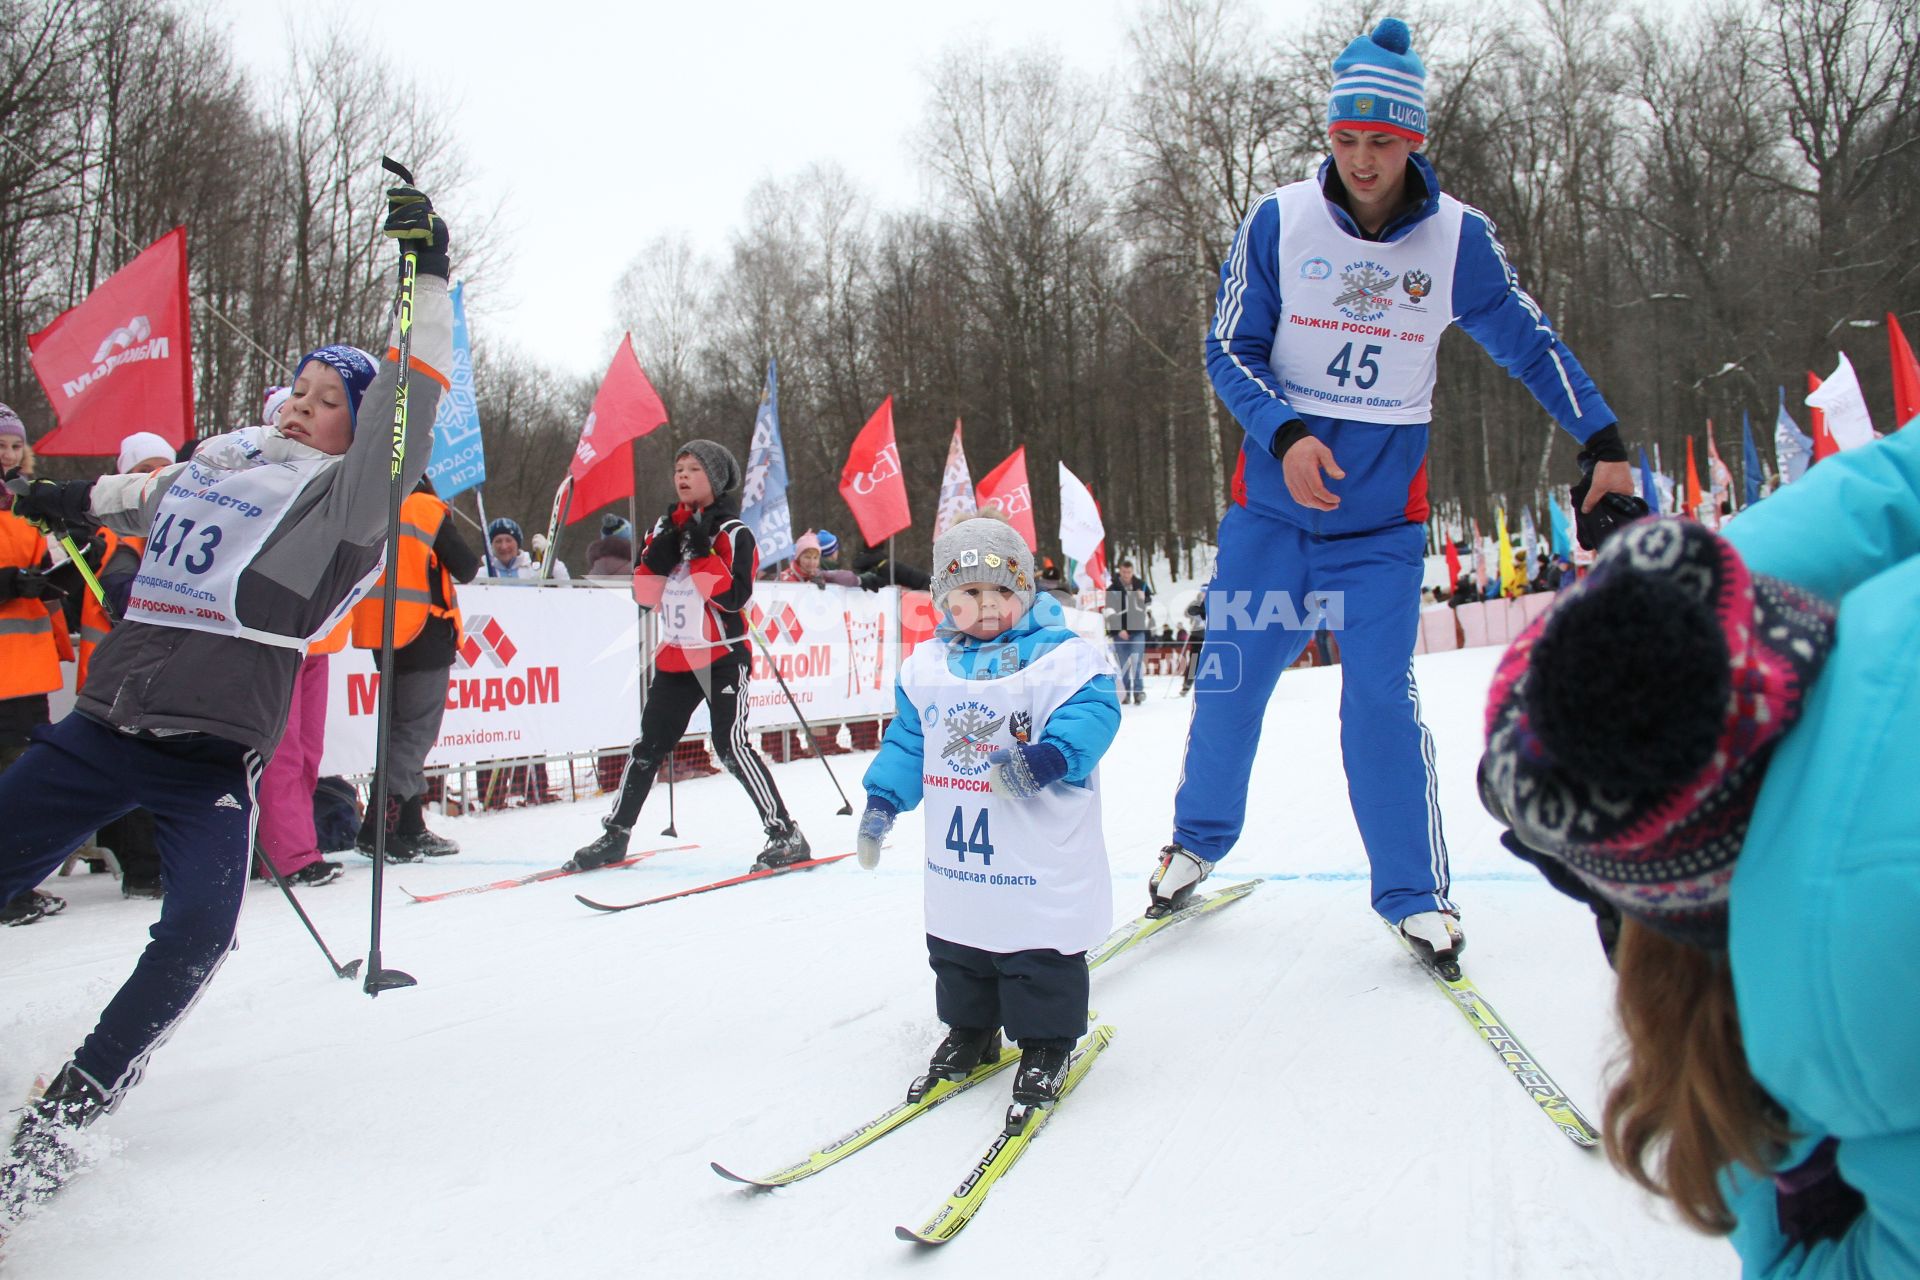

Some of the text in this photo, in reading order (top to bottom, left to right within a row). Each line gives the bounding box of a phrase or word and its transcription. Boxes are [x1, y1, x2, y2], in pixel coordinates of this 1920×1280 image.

[1389, 102, 1425, 129] LUKOIL
[1345, 260, 1391, 278] ЛЫЖНЯ
[1371, 296, 1394, 306] 2016
[1339, 306, 1384, 323] РОССИИ
[1290, 314, 1339, 331] ЛЫЖНЯ
[1341, 322, 1390, 338] РОССИИ
[1400, 331, 1425, 343] 2016
[1326, 341, 1382, 390] 45
[1285, 379, 1402, 408] Нижегородская область
[174, 582, 217, 602] область
[142, 598, 187, 615] РОССИИ
[197, 607, 226, 622] 2016
[347, 666, 560, 716] МсидоМ
[947, 701, 997, 720] ЛЫЖНЯ
[976, 743, 1000, 753] 2016
[947, 759, 992, 777] РОССИИ
[951, 778, 993, 793] РОССИ
[945, 805, 994, 866] 44
[990, 873, 1037, 887] область
[1478, 1026, 1566, 1102] FISCHER
[921, 1204, 953, 1237] FISCHER
